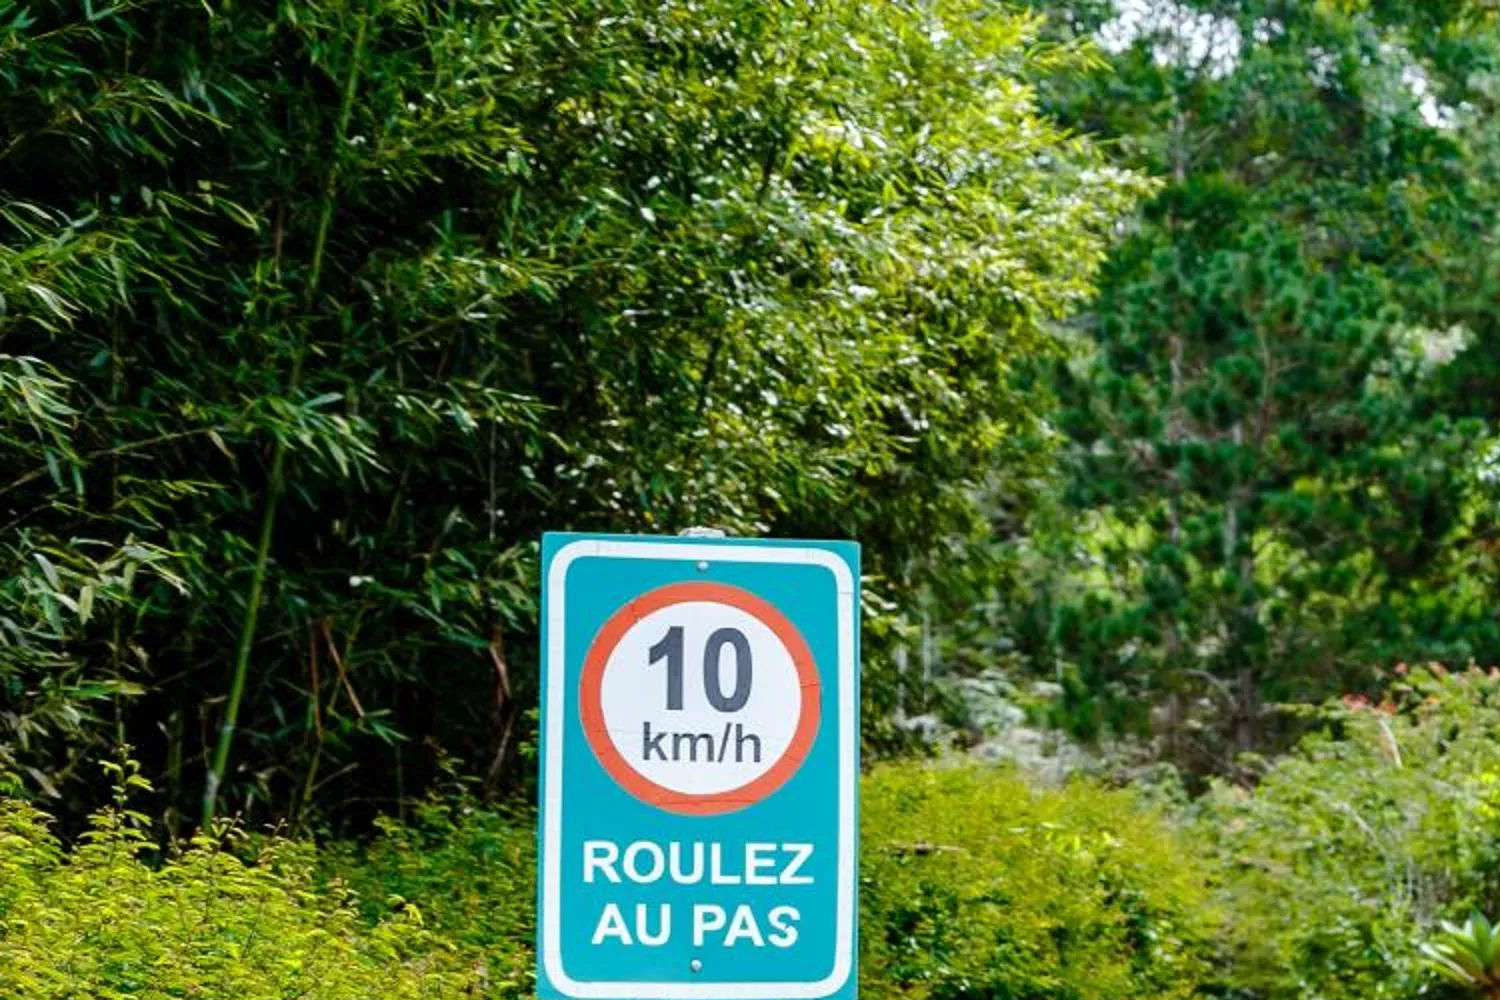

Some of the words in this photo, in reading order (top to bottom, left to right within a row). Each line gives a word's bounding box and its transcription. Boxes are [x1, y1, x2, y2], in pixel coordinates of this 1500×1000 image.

[648, 625, 753, 713] 10
[643, 722, 762, 763] km/h
[583, 840, 814, 885] ROULEZ
[591, 903, 671, 945] AU
[693, 905, 801, 948] PAS
